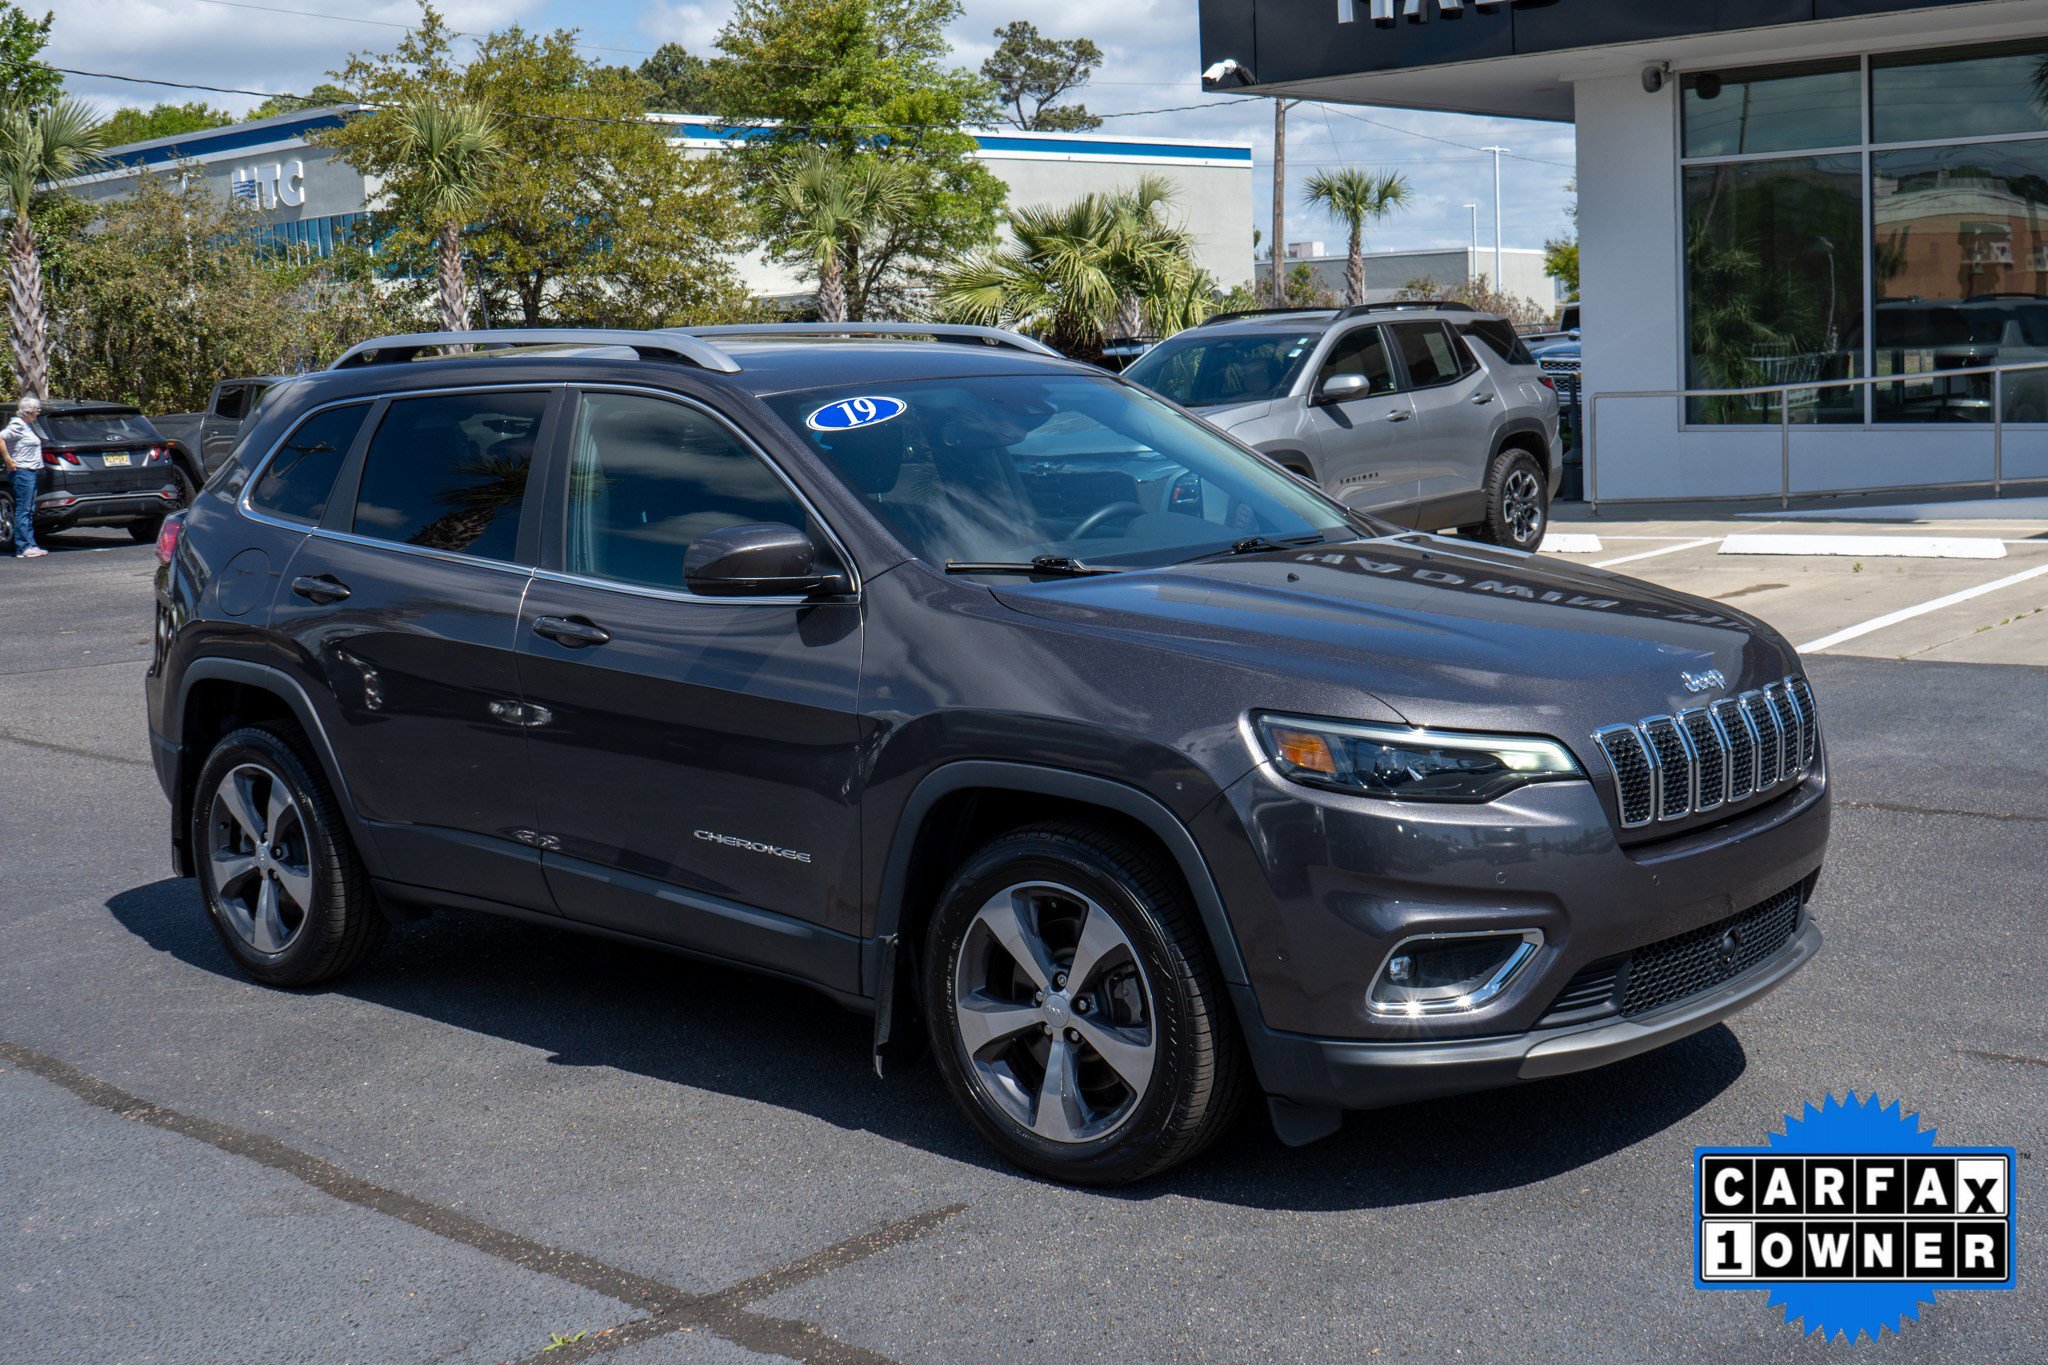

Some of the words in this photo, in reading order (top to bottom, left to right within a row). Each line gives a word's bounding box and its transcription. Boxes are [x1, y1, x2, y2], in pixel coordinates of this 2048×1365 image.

[231, 160, 305, 211] HTC
[837, 398, 876, 426] 19
[1681, 669, 1726, 693] Jeep
[694, 829, 811, 863] CHEROKEE
